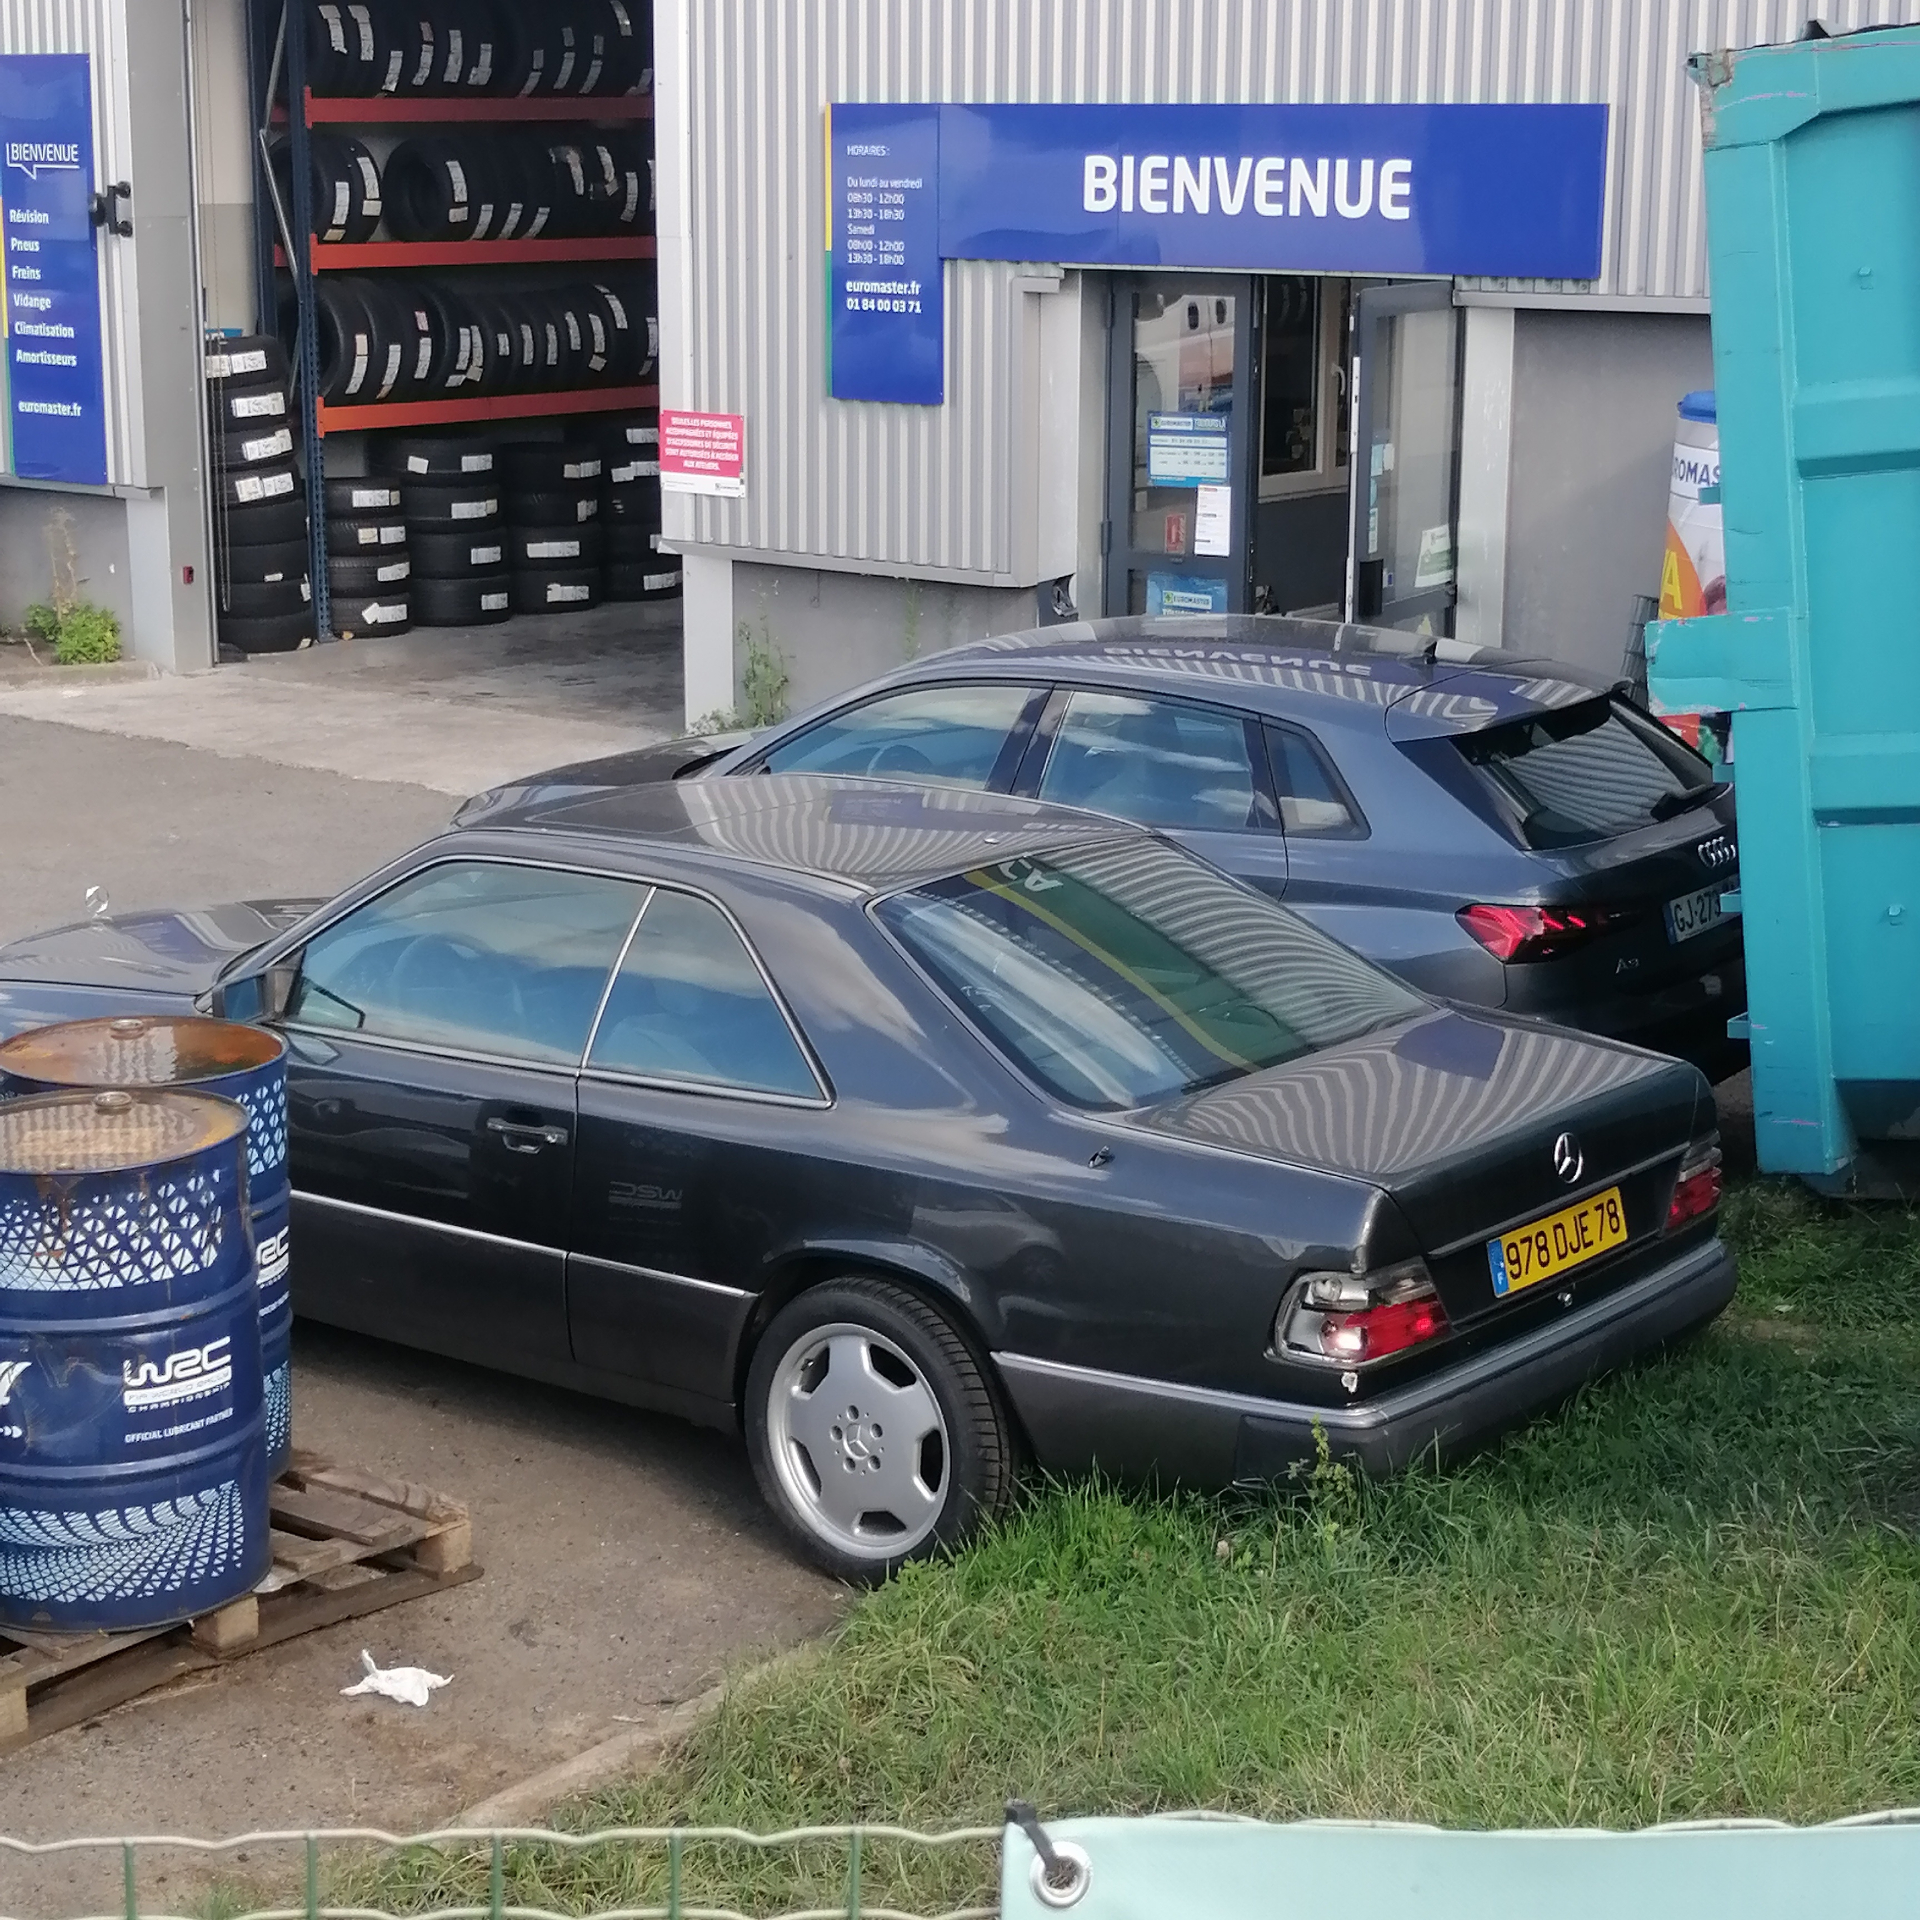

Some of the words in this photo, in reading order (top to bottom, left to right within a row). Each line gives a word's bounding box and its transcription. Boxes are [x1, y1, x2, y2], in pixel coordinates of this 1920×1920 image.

[11, 143, 79, 163] BIENVENUE
[847, 176, 858, 188] Du
[879, 179, 889, 189] au
[890, 178, 923, 189] vendredi
[1083, 155, 1412, 220] BIENVENUE
[9, 209, 49, 225] Révision
[847, 208, 873, 220] 13h30
[847, 223, 875, 235] Samedi
[10, 237, 40, 252] Pneus
[879, 240, 905, 252] 12h00
[847, 252, 873, 264] 13h30
[12, 265, 41, 280] Freins
[845, 280, 922, 295] euromaster.fr
[13, 293, 51, 311] Vidange
[846, 298, 860, 311] 01
[861, 298, 875, 312] 84
[877, 299, 891, 312] 00
[892, 299, 906, 313] 03
[908, 300, 922, 314] 71
[14, 321, 75, 339] Climatisation
[16, 348, 77, 367] Amortisseurs
[18, 399, 82, 417] euromaster.fr
[256, 1225, 290, 1265] RC
[1506, 1230, 1550, 1280] 978
[1553, 1210, 1594, 1261] DJE
[1594, 1198, 1620, 1242] 78
[123, 1335, 231, 1387] WRC
[125, 1429, 163, 1443] OFFICIAL
[163, 1418, 205, 1437] LUBRICANT
